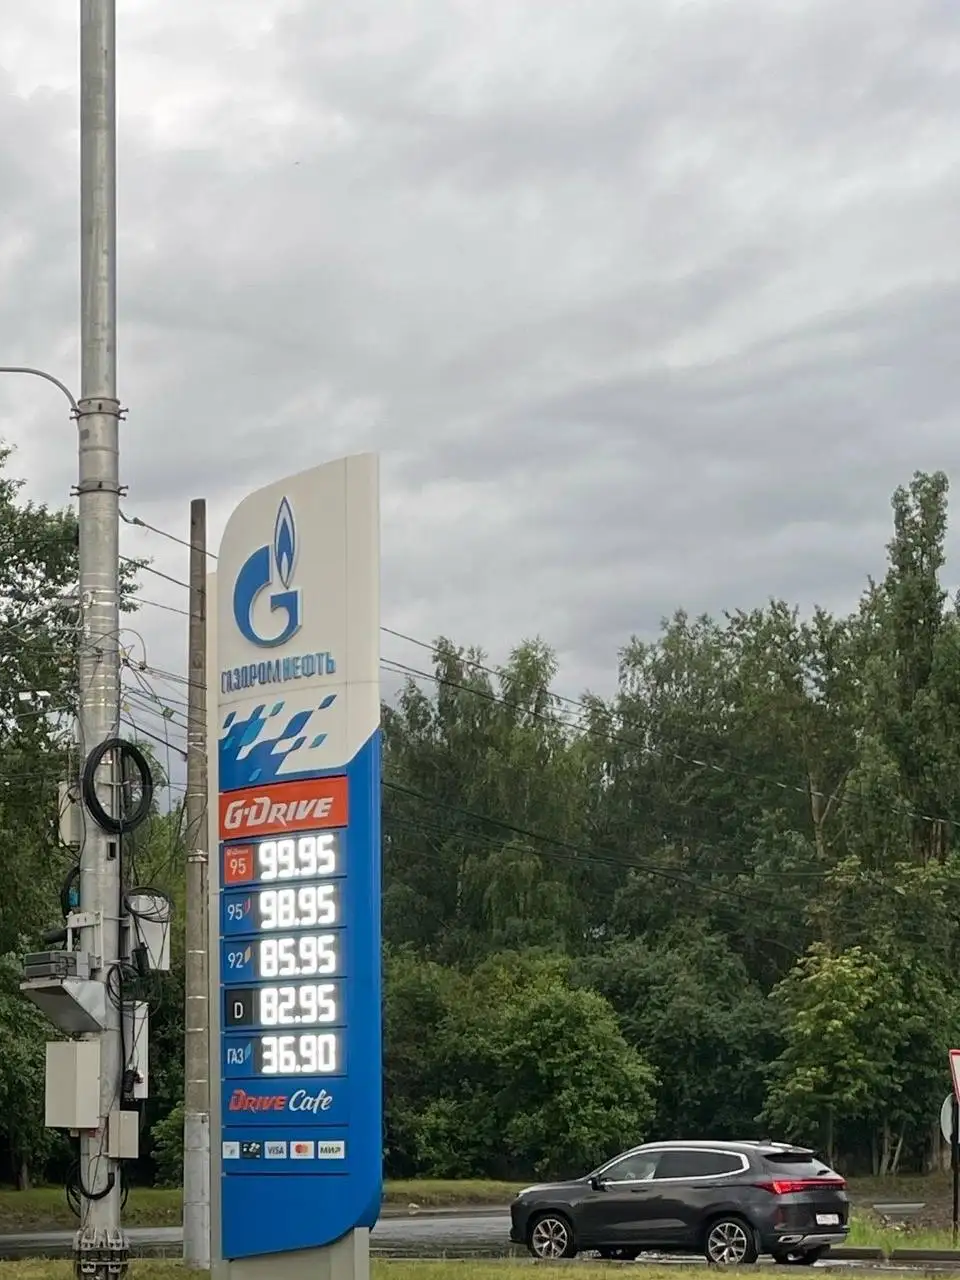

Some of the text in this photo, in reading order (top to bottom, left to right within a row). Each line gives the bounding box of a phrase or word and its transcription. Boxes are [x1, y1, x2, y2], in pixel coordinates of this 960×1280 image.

[230, 834, 336, 880] 95 99.95
[227, 884, 336, 929] 95 98.95
[227, 934, 336, 977] 92 85.95
[234, 983, 336, 1025] D 82.95
[227, 1033, 337, 1074] ГАЗ 36.90
[288, 1088, 333, 1114] Cafe
[268, 1146, 285, 1154] VISA
[320, 1146, 341, 1154] МИР
